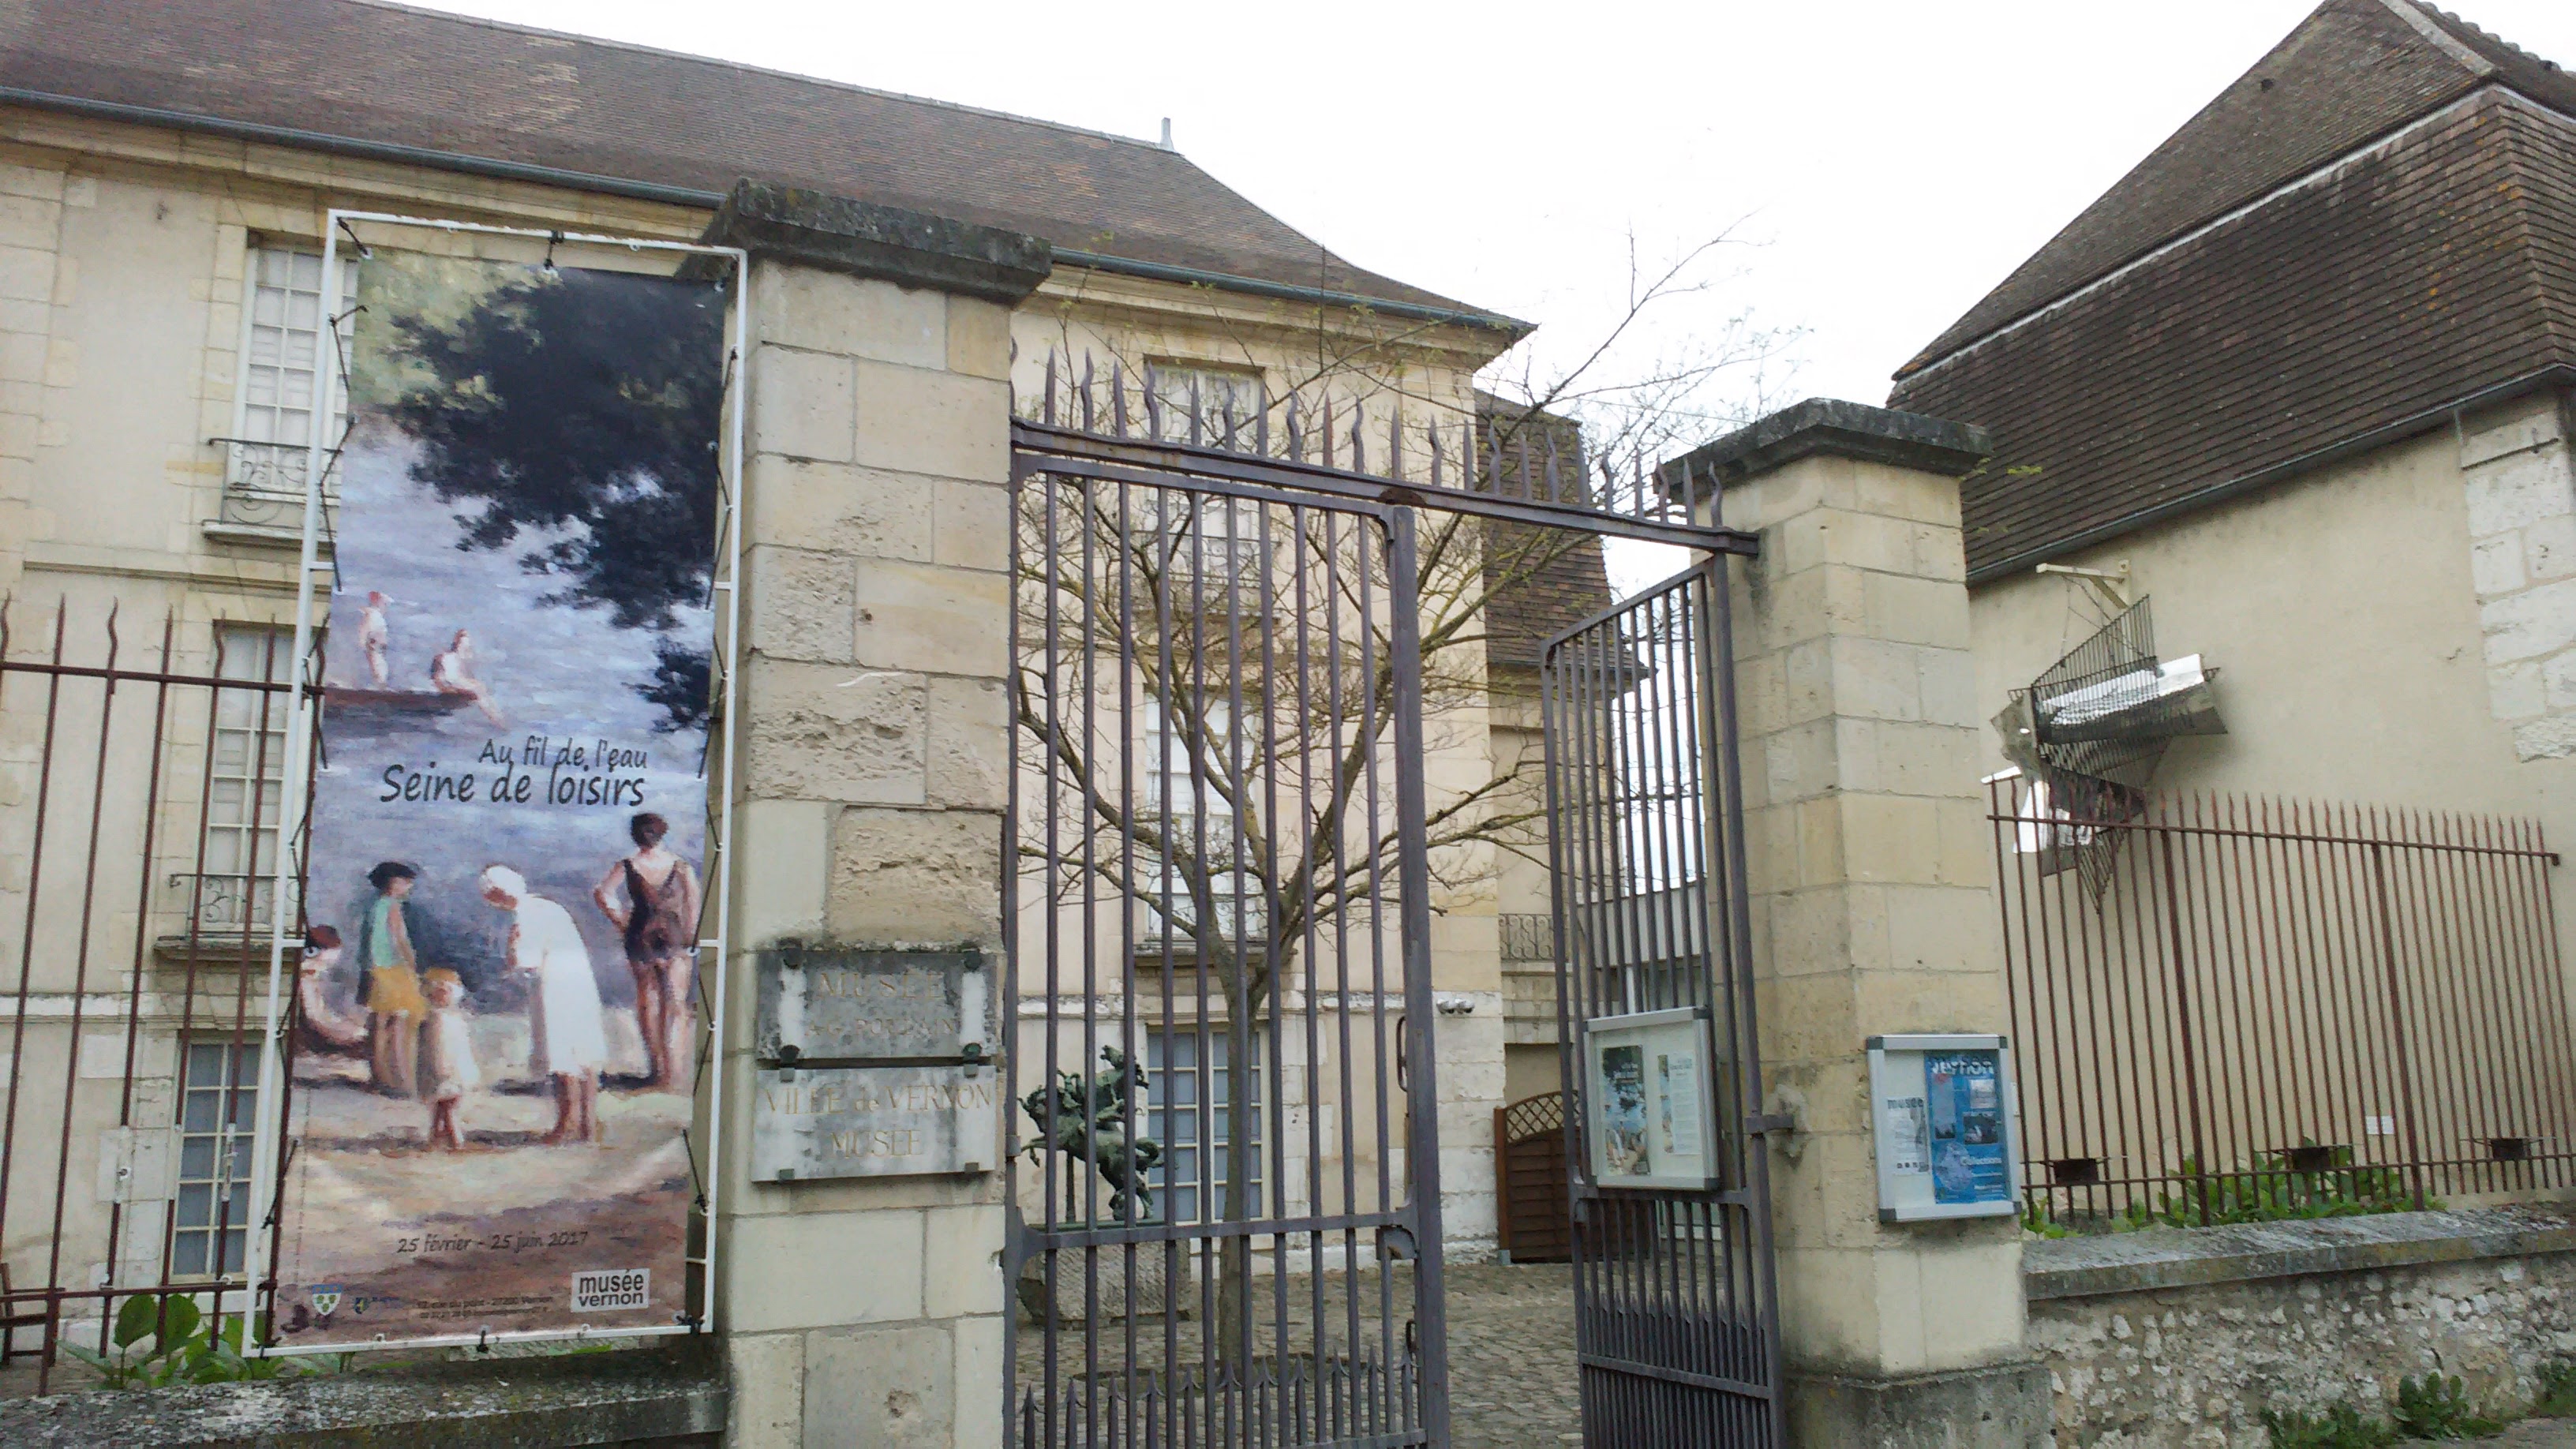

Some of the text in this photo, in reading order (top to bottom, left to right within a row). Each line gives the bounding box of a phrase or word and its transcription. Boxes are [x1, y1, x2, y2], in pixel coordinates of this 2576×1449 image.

[478, 736, 648, 769] Au fil de l'eau
[380, 761, 646, 807] Seine de loisirs
[764, 1084, 991, 1114] VILLE de VERNON
[831, 1130, 923, 1159] MUSEE
[396, 1237, 420, 1253] 25
[424, 1233, 474, 1252] février
[490, 1234, 513, 1250] 25
[514, 1230, 542, 1254] juin
[549, 1230, 589, 1247] 2017
[578, 1268, 644, 1294] musée
[578, 1292, 644, 1307] vernon
